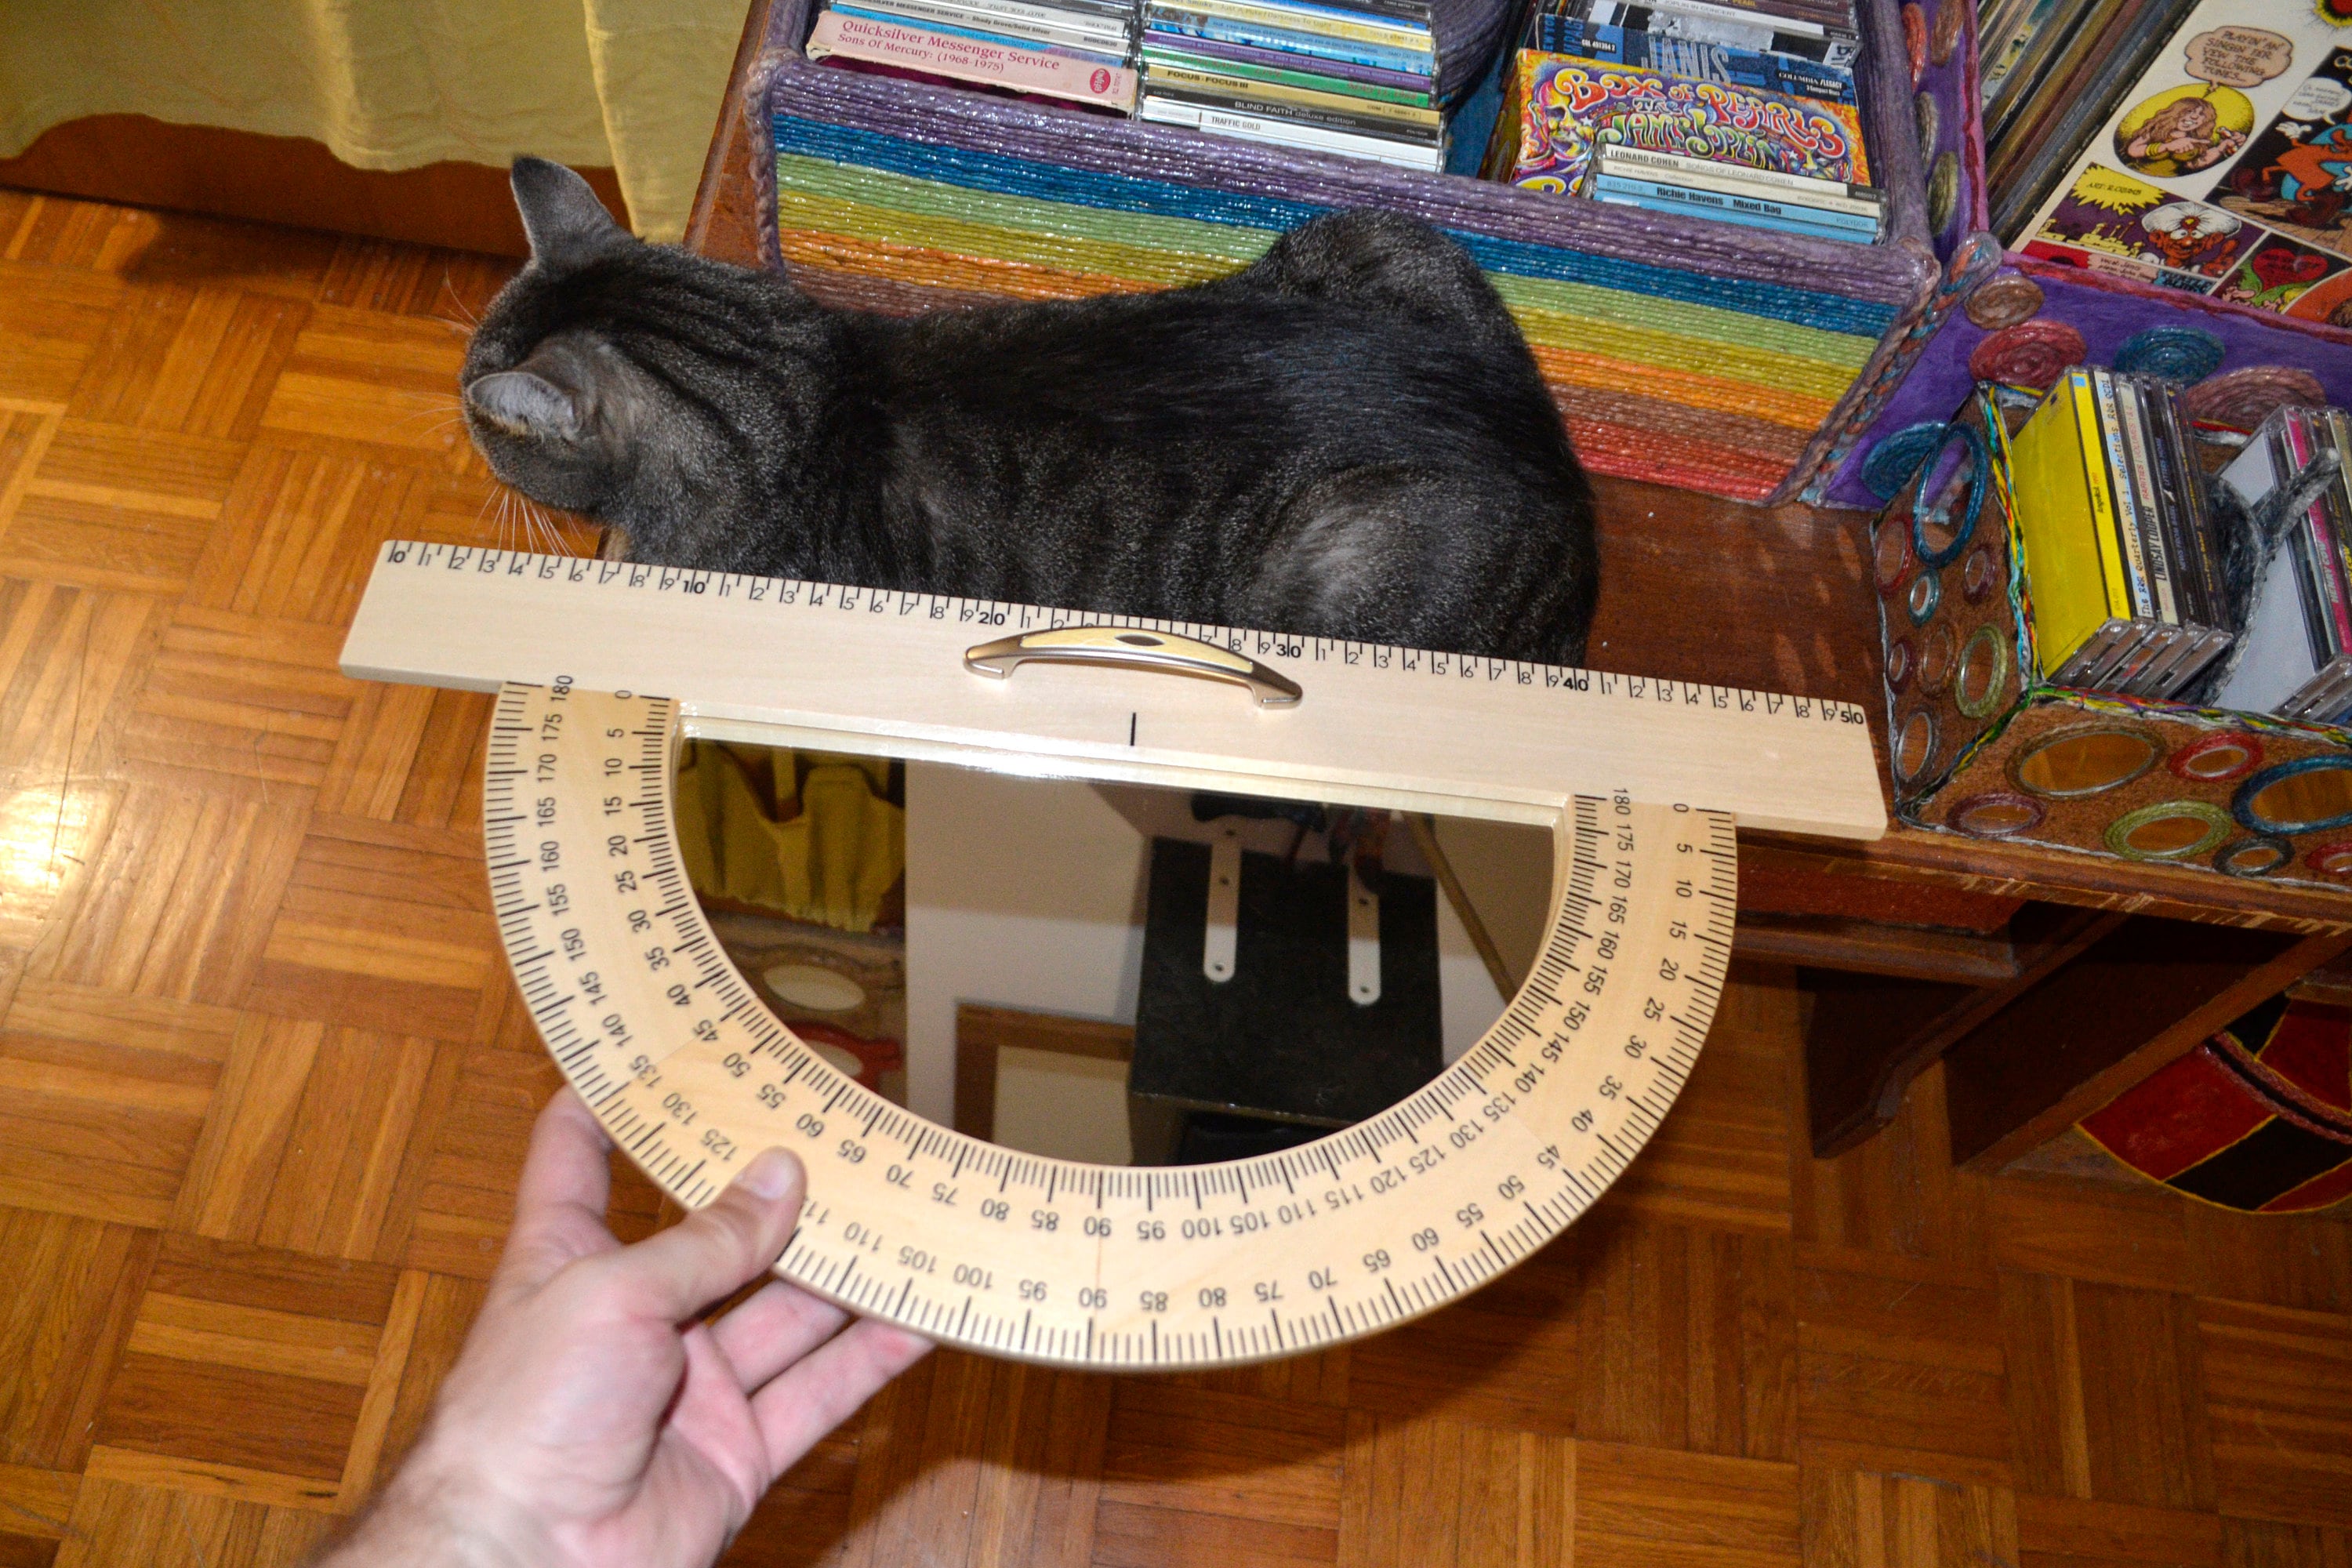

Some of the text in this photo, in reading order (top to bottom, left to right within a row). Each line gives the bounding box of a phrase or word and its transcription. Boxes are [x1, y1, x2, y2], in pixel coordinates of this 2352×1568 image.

[936, 9, 964, 20] SERVICE
[837, 33, 866, 45] Sons
[867, 38, 883, 49] Of
[884, 42, 933, 60] Mercury:
[841, 19, 925, 44] Quicksilver
[927, 35, 1004, 61] Messenger
[1007, 52, 1060, 70] Service
[1641, 35, 1731, 87] JANIS
[1167, 70, 1200, 81] FOCUS
[1205, 76, 1238, 87] FOCUS
[1778, 71, 1818, 85] COLUMBIA
[1210, 116, 1260, 130] TRAFFIC GOLD
[1234, 101, 1356, 126] BLIND FAITH deluxe edition
[1610, 149, 1649, 162] LEONARD
[1650, 156, 1679, 168] COHEN
[1685, 162, 1714, 173] SONGS
[1726, 168, 1765, 180] LEONARD
[1765, 175, 1794, 186] COHEN
[1656, 186, 1686, 199] Richie
[1688, 192, 1724, 205] Havens
[1732, 198, 1762, 211] Mixed
[1762, 204, 1782, 215] Bag
[2111, 426, 2127, 479] Selections
[2138, 465, 2150, 499] RARITIES
[2122, 500, 2132, 516] Vol
[2143, 506, 2159, 542] COOPER
[2129, 523, 2143, 572] Quarterly
[2151, 542, 2166, 581] LINDSAY
[2318, 540, 2339, 603] HENRY COW
[2141, 599, 2151, 615] The
[394, 550, 406, 563] 0
[1549, 676, 1559, 687] 9
[1633, 685, 1643, 698] 2
[1662, 689, 1672, 702] 3
[1689, 693, 1698, 705] 4
[1718, 696, 1727, 709] 5
[1744, 699, 1754, 712] 6
[1772, 702, 1781, 713] 7
[1799, 706, 1809, 717] 8
[1826, 709, 1835, 720] 9
[604, 690, 1634, 1241] 0 5 10 15 20 25 30 35 40 45 50 55 60 65 70 75 80 85 90 95 100 105 110 115 120 125 130 135 140 145 150 155 160 165 170 175 180
[537, 676, 1693, 1312] 180 175 170 165 160 155 150 145 140 135 130 125 110 105 100 95 90 85 80 75 70 65 60 55 50 45 40 35 30 25 20 15 10 5 0
